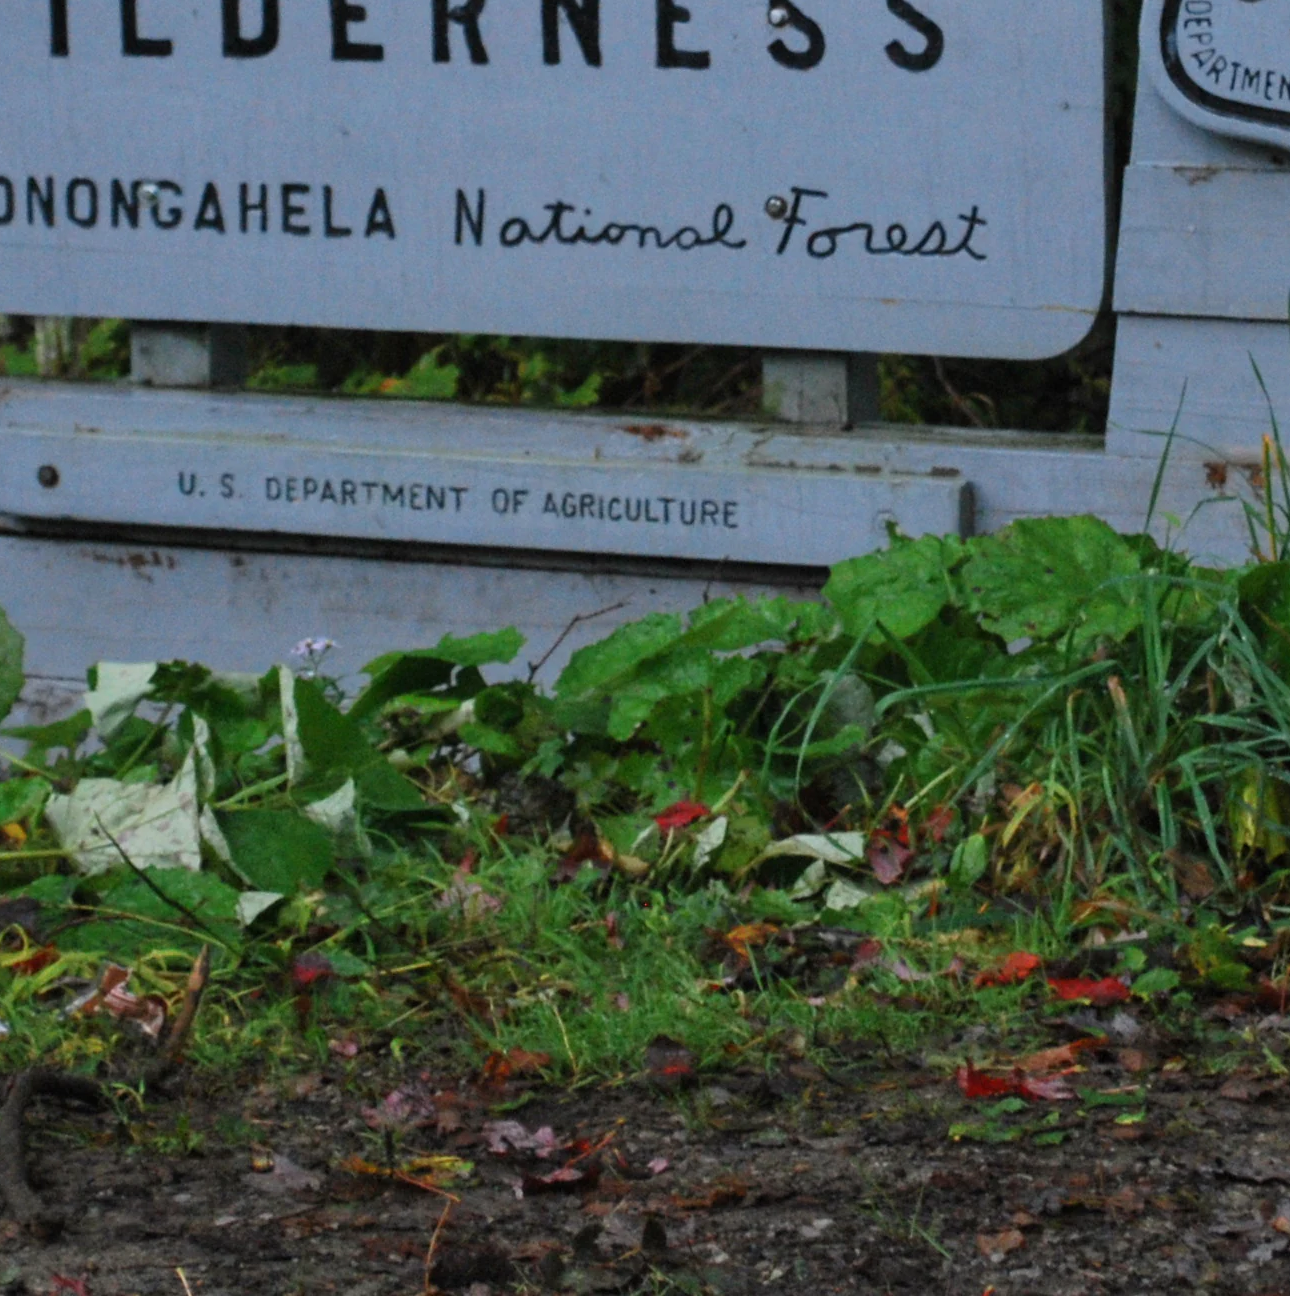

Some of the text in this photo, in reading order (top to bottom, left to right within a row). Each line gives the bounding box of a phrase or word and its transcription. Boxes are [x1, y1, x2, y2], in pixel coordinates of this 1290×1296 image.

[454, 186, 748, 253] National
[769, 185, 989, 262] Forest
[264, 475, 470, 513] DEPARTMENT
[491, 487, 528, 514] OF
[541, 491, 739, 530] AGRICULTURE
